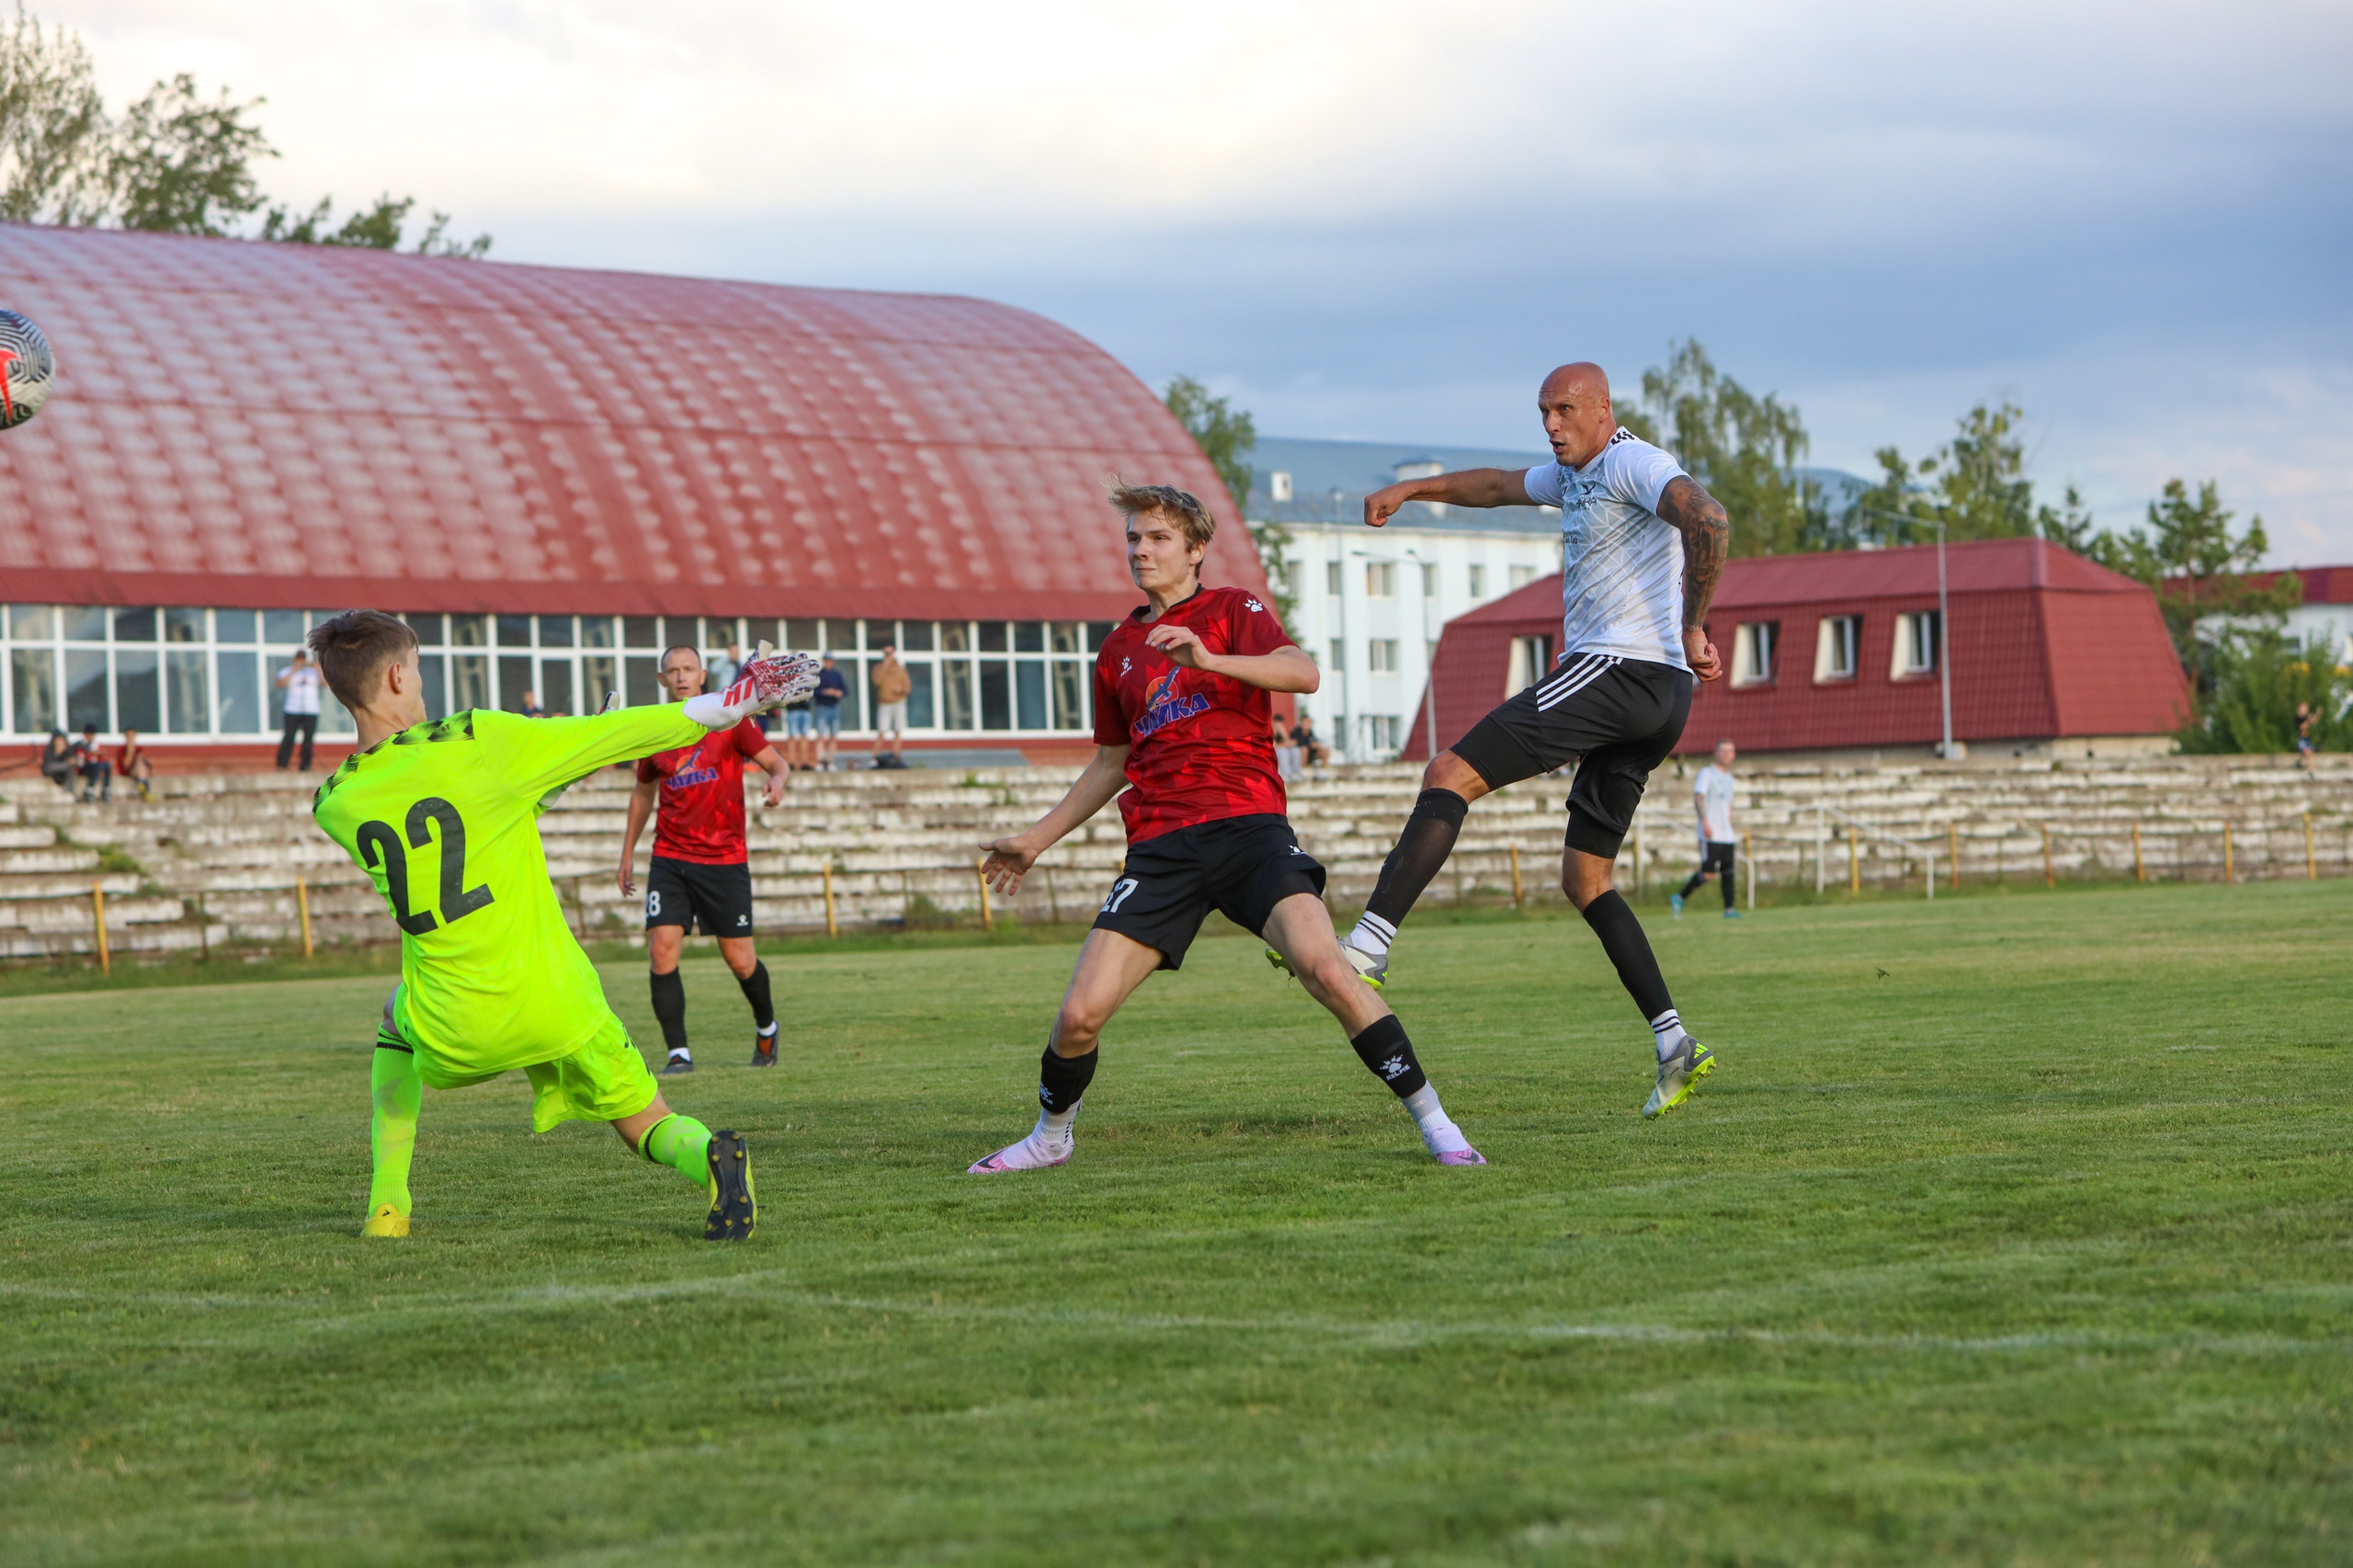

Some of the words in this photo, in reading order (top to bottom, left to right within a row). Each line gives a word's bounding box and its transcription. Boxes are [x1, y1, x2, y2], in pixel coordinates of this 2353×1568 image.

[356, 796, 495, 937] 22
[645, 890, 661, 917] 8
[1385, 1063, 1411, 1081] KELME
